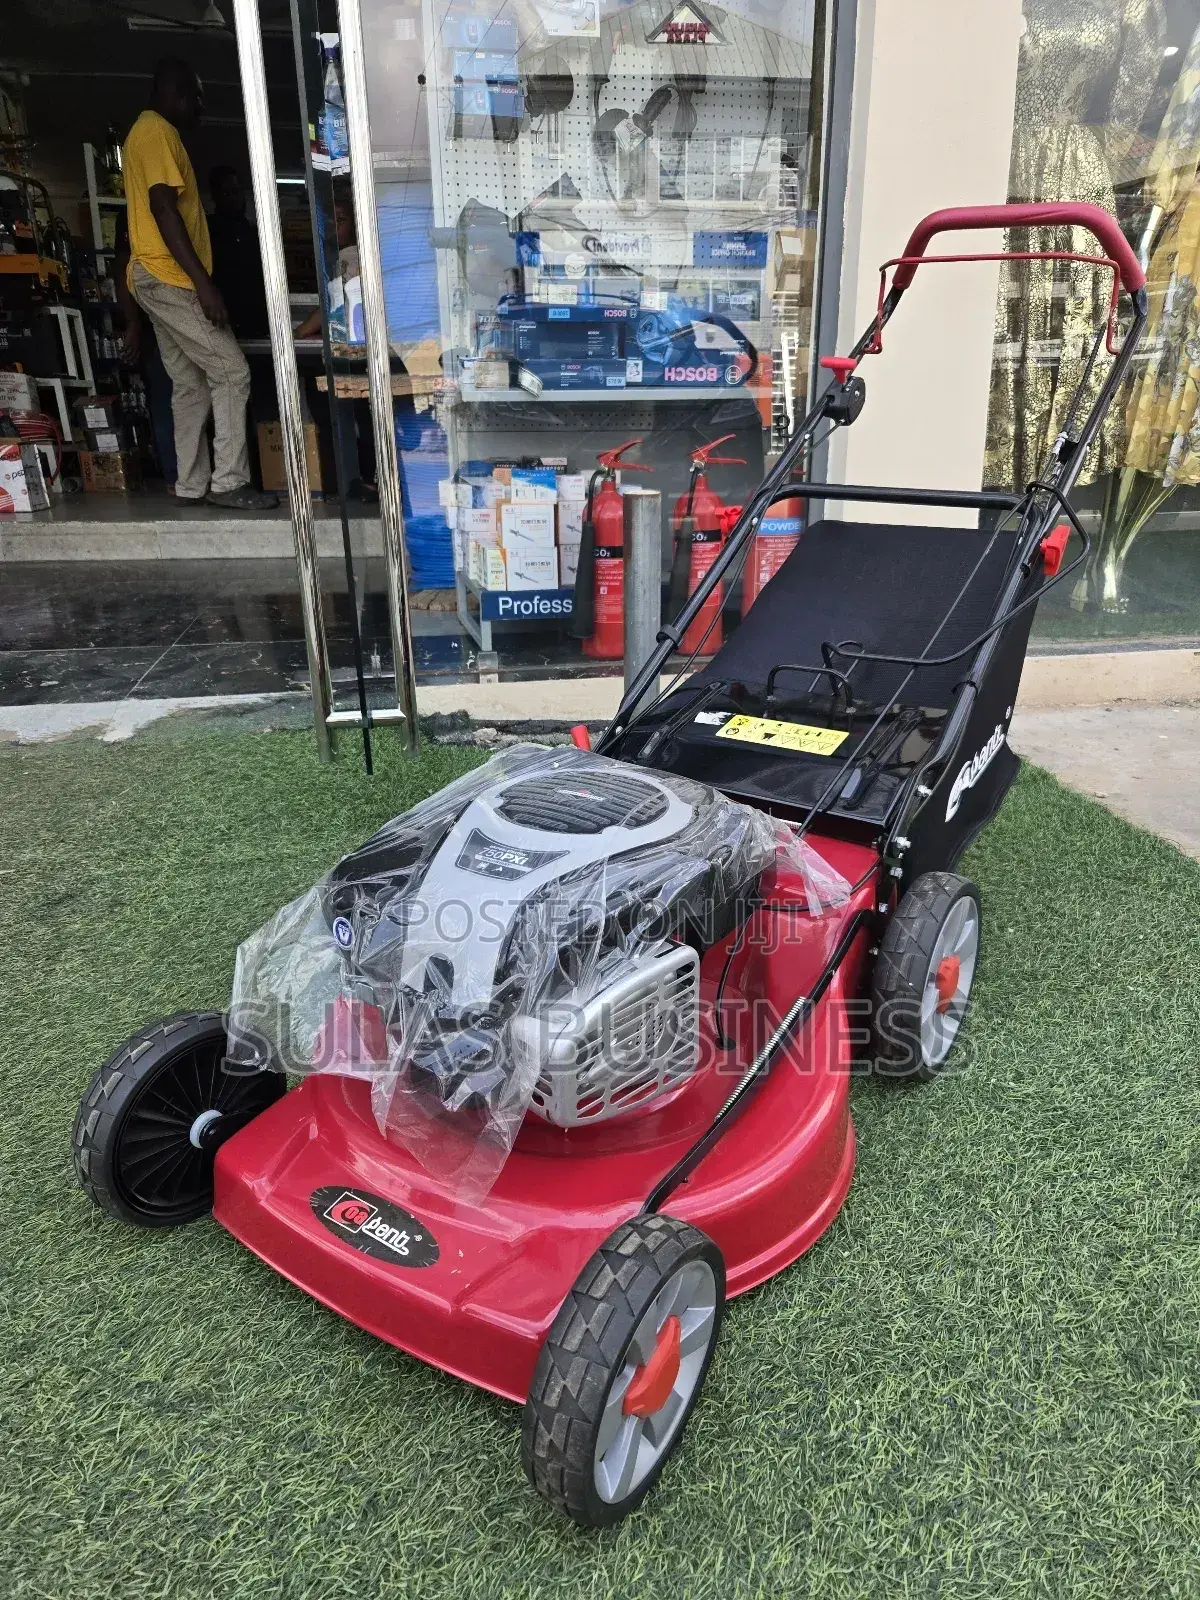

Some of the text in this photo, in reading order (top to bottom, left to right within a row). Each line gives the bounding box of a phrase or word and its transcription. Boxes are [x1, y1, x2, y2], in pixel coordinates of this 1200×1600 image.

[604, 309, 627, 318] BOSCH
[664, 367, 718, 382] BOSCH
[498, 595, 573, 615] Profess
